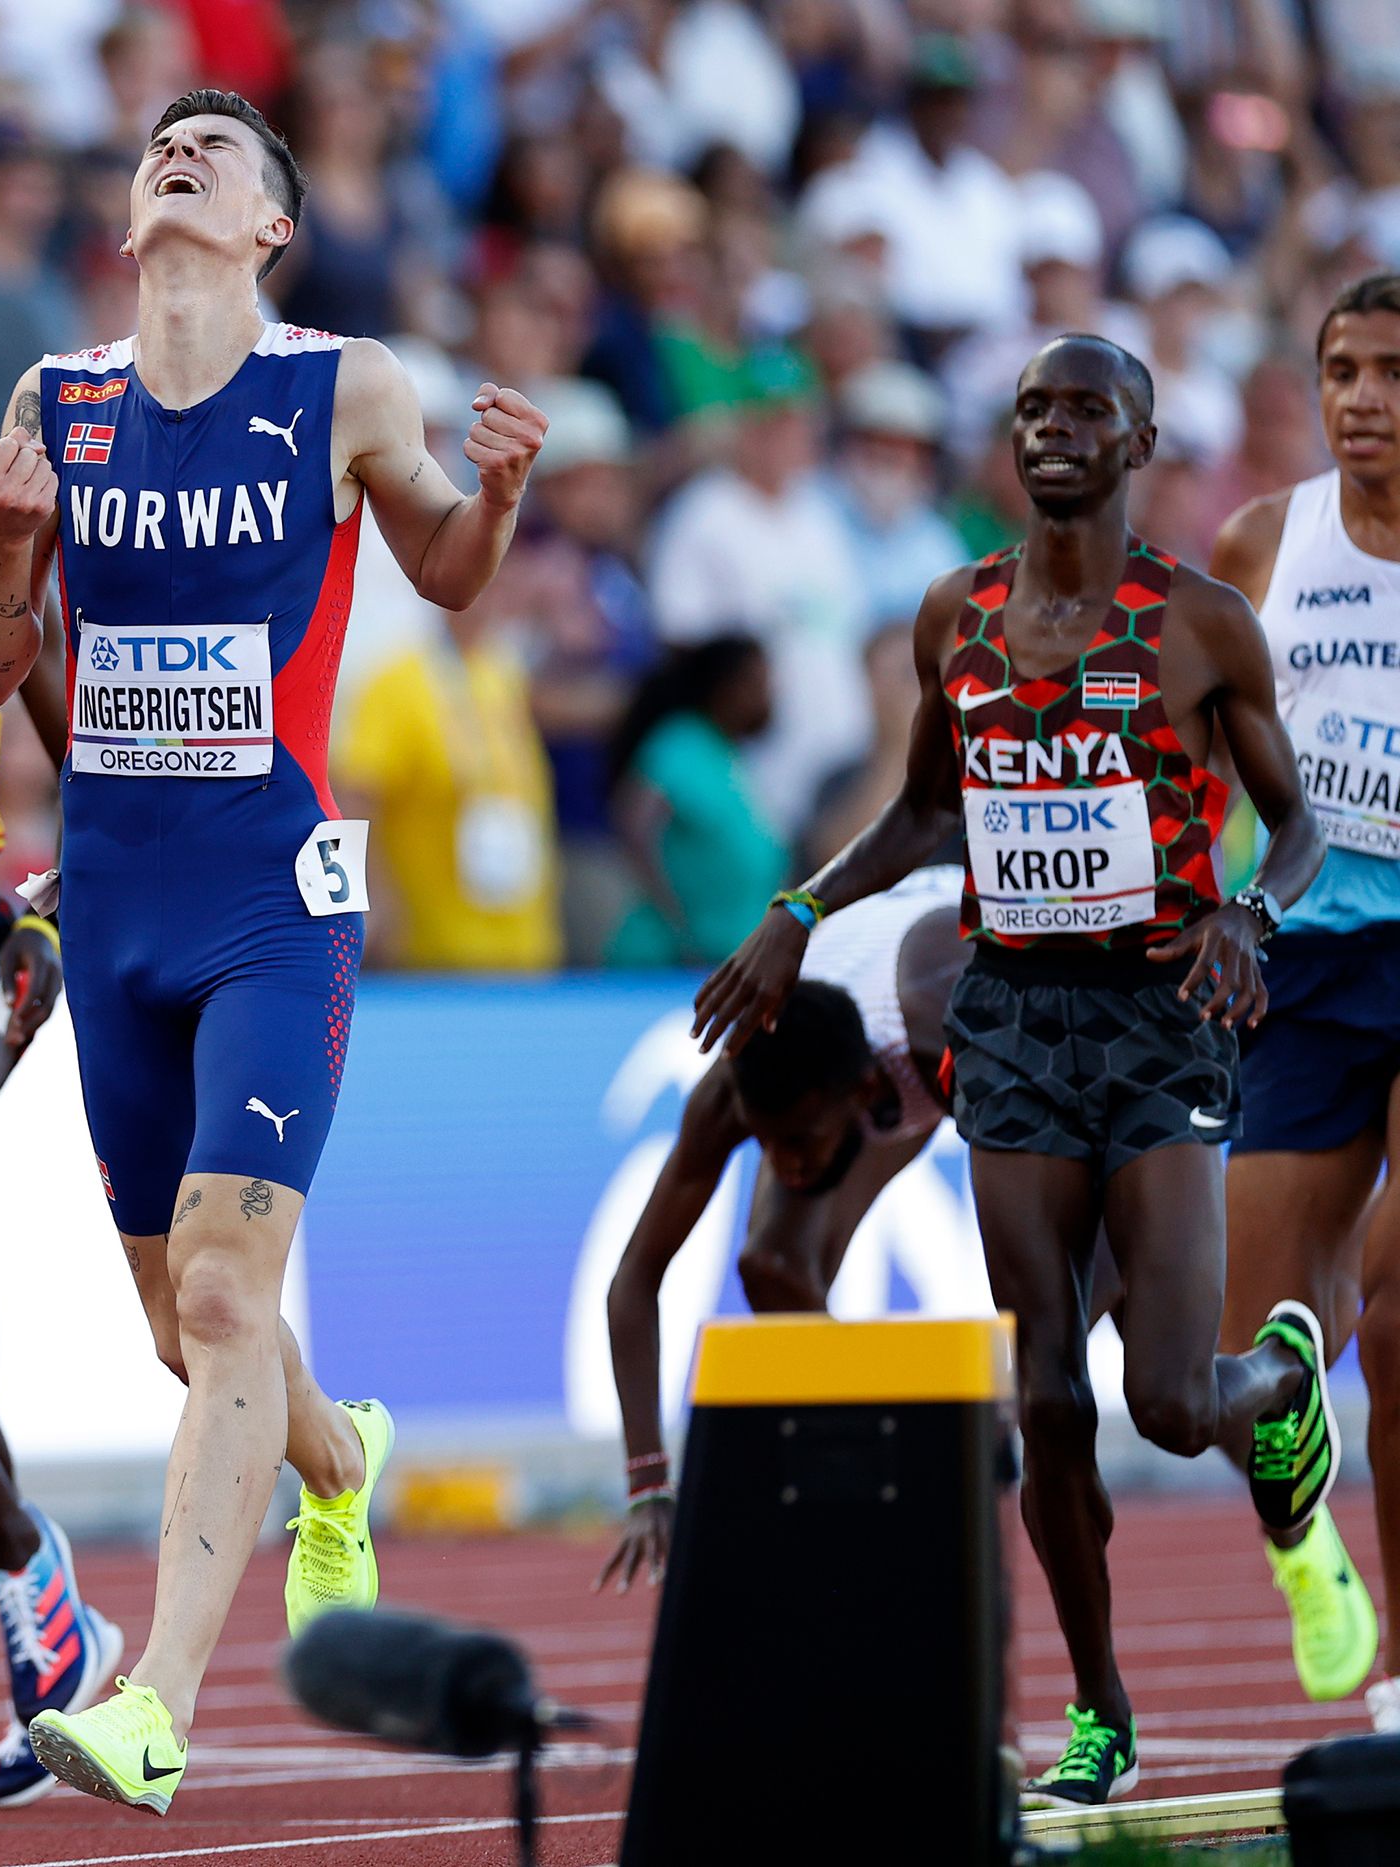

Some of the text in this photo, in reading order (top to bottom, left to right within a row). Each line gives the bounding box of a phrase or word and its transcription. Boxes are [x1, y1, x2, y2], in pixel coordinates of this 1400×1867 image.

[84, 383, 123, 399] EXTRA
[71, 480, 289, 550] NORWAY
[118, 636, 238, 671] TDK
[1288, 640, 1400, 671] GUATE
[79, 685, 262, 732] INGEBRIGTSEN
[100, 749, 237, 771] OREGON22
[963, 732, 1132, 785] KENYA
[1298, 753, 1400, 813] GRIJA
[1009, 798, 1117, 833] TDK
[316, 838, 350, 903] 5
[996, 848, 1110, 890] KROP
[996, 904, 1124, 929] OREGON22
